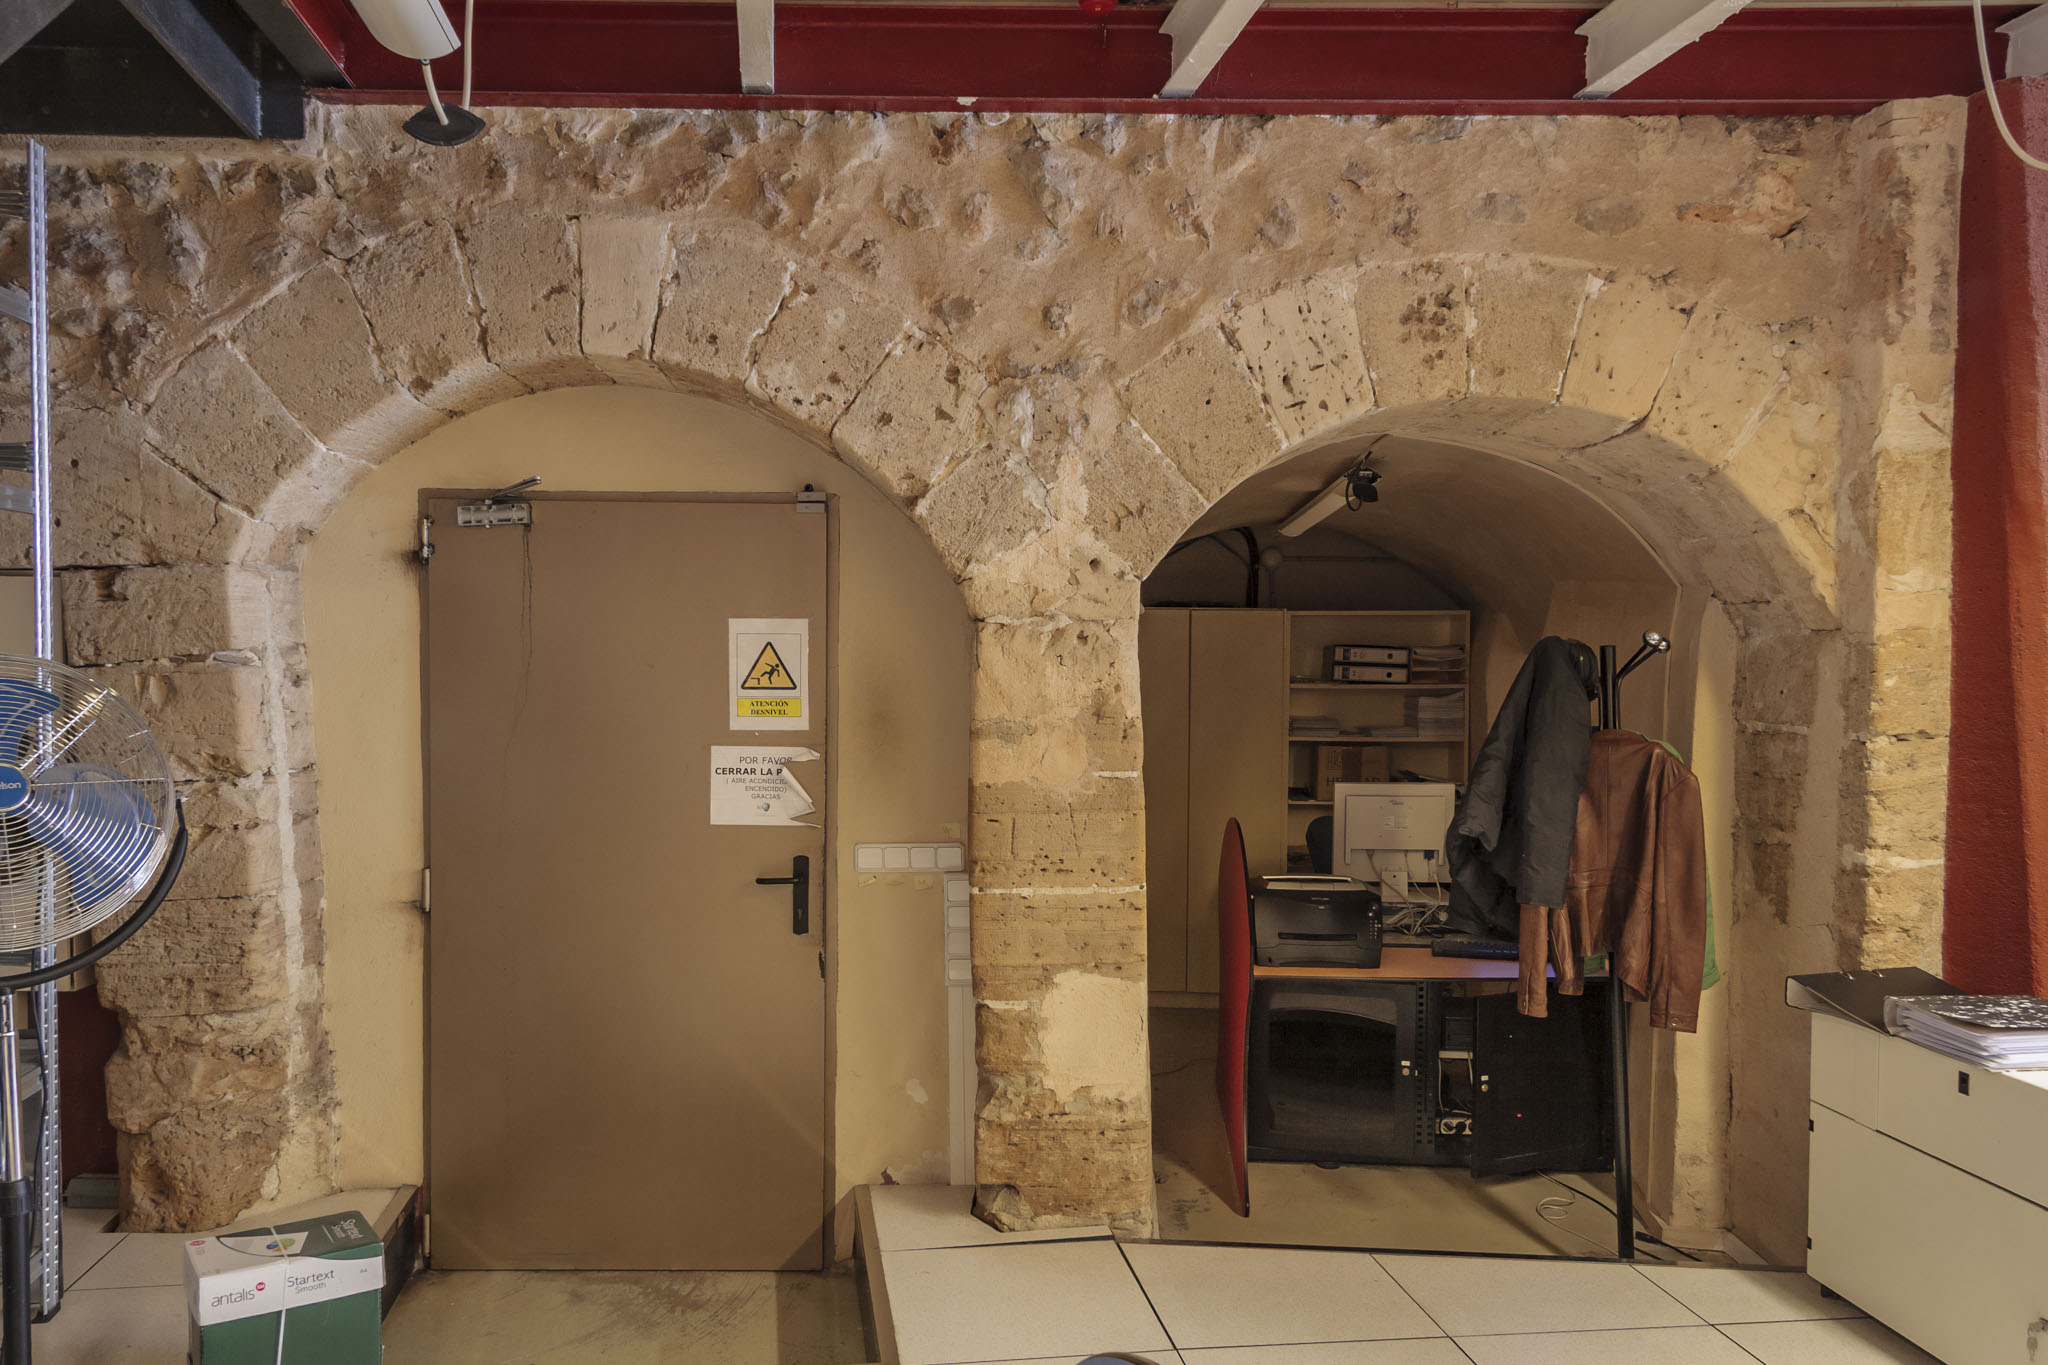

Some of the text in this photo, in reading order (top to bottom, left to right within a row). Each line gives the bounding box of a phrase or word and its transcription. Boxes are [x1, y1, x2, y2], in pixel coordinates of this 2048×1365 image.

[739, 756, 758, 764] POR
[715, 767, 757, 775] CERRAR
[760, 767, 773, 776] LA
[287, 1269, 335, 1288] Startext
[295, 1281, 327, 1295] Smooth
[211, 1287, 256, 1308] antalis
